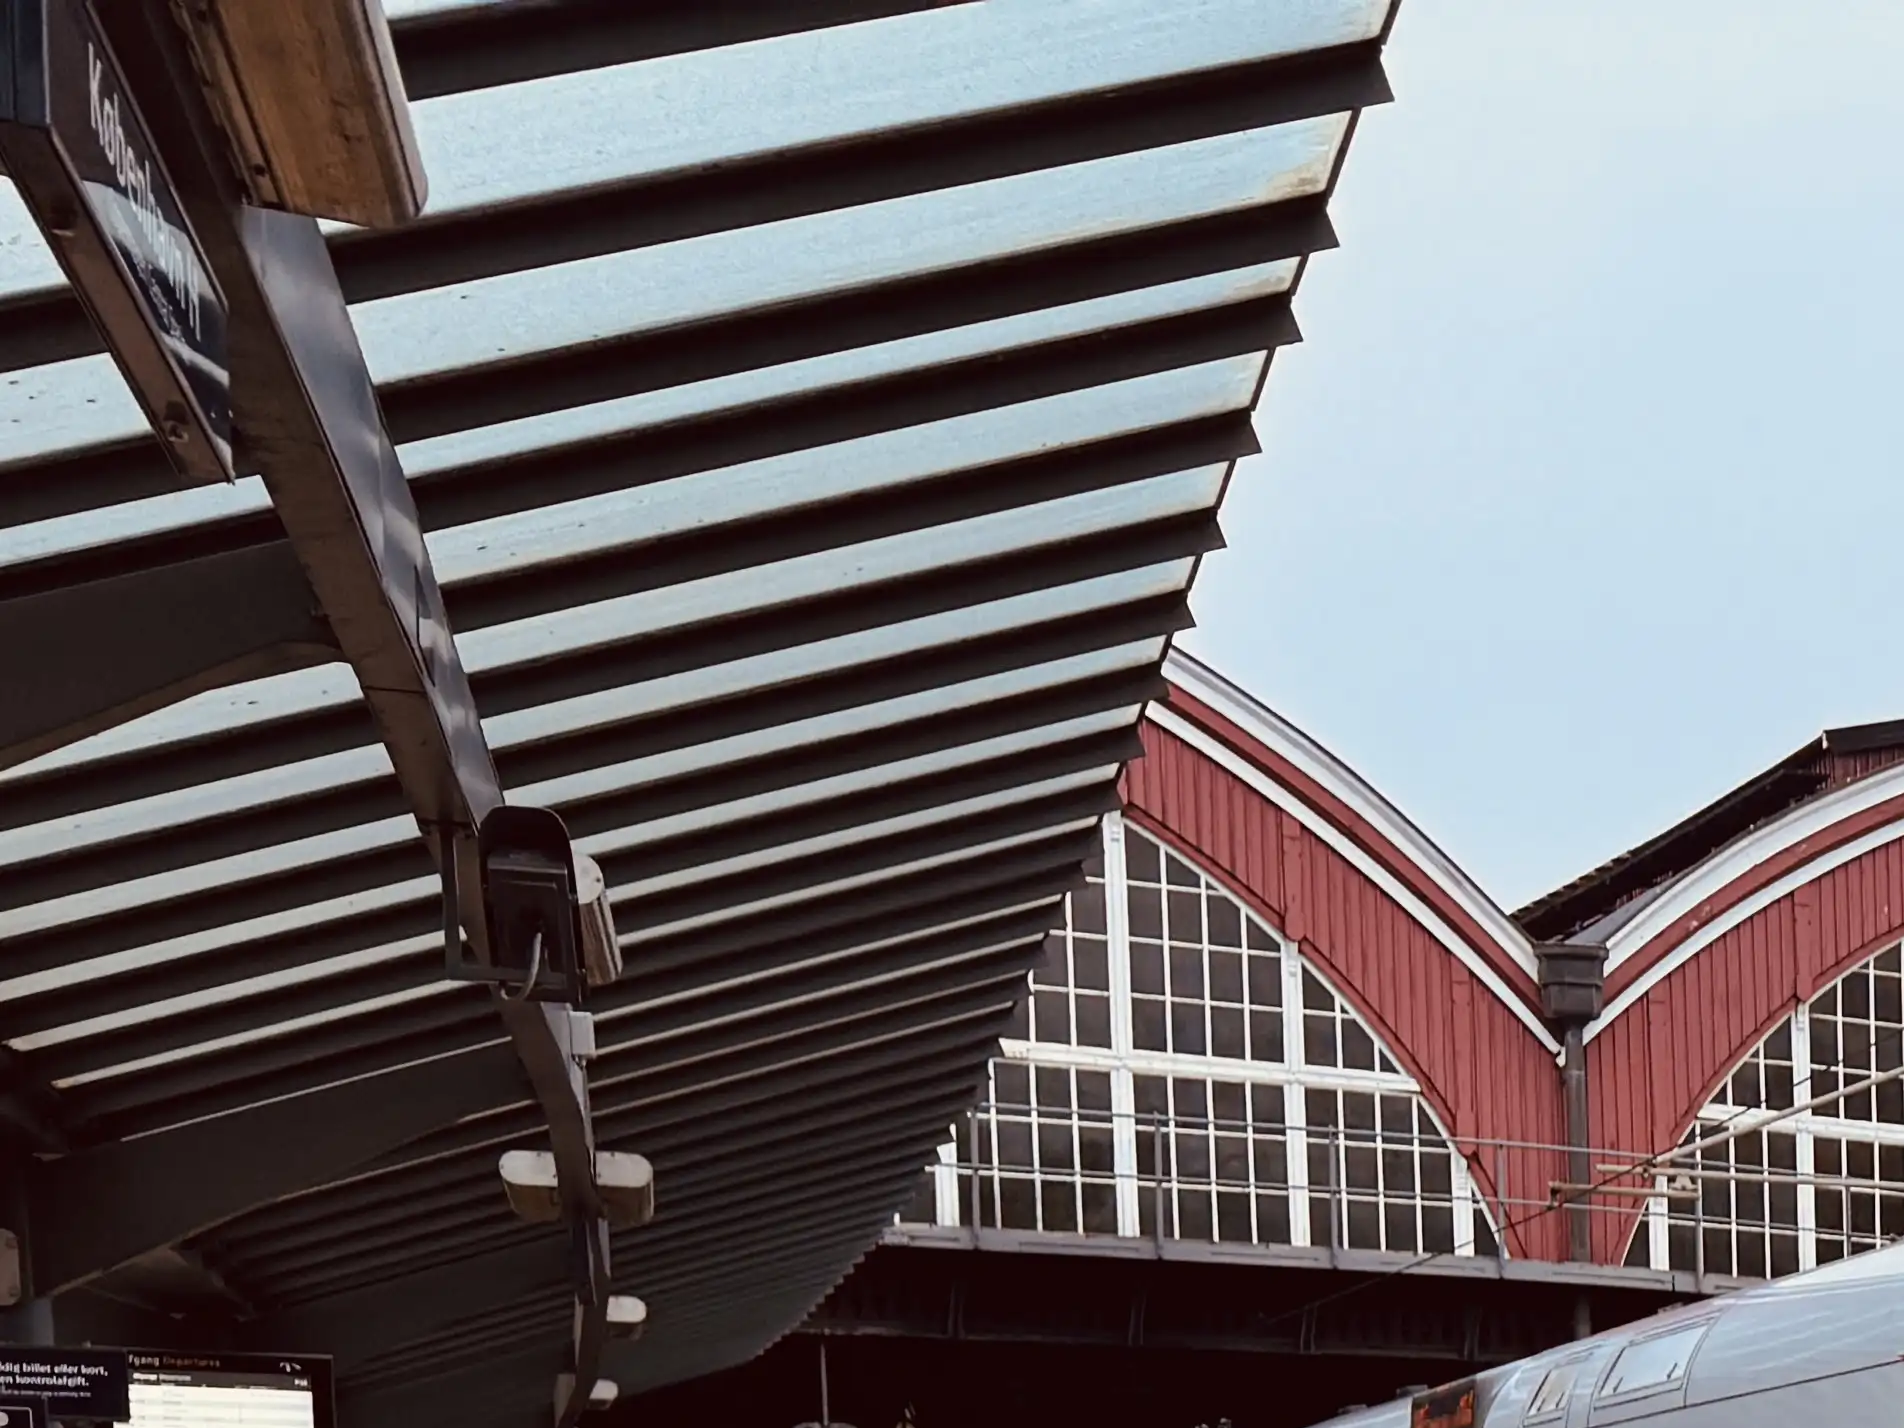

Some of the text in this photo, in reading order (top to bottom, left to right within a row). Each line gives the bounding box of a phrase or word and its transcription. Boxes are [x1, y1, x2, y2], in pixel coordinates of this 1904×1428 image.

[88, 42, 186, 310] København
[127, 1354, 160, 1367] fgang
[23, 1362, 51, 1374] billet
[54, 1363, 78, 1375] eller
